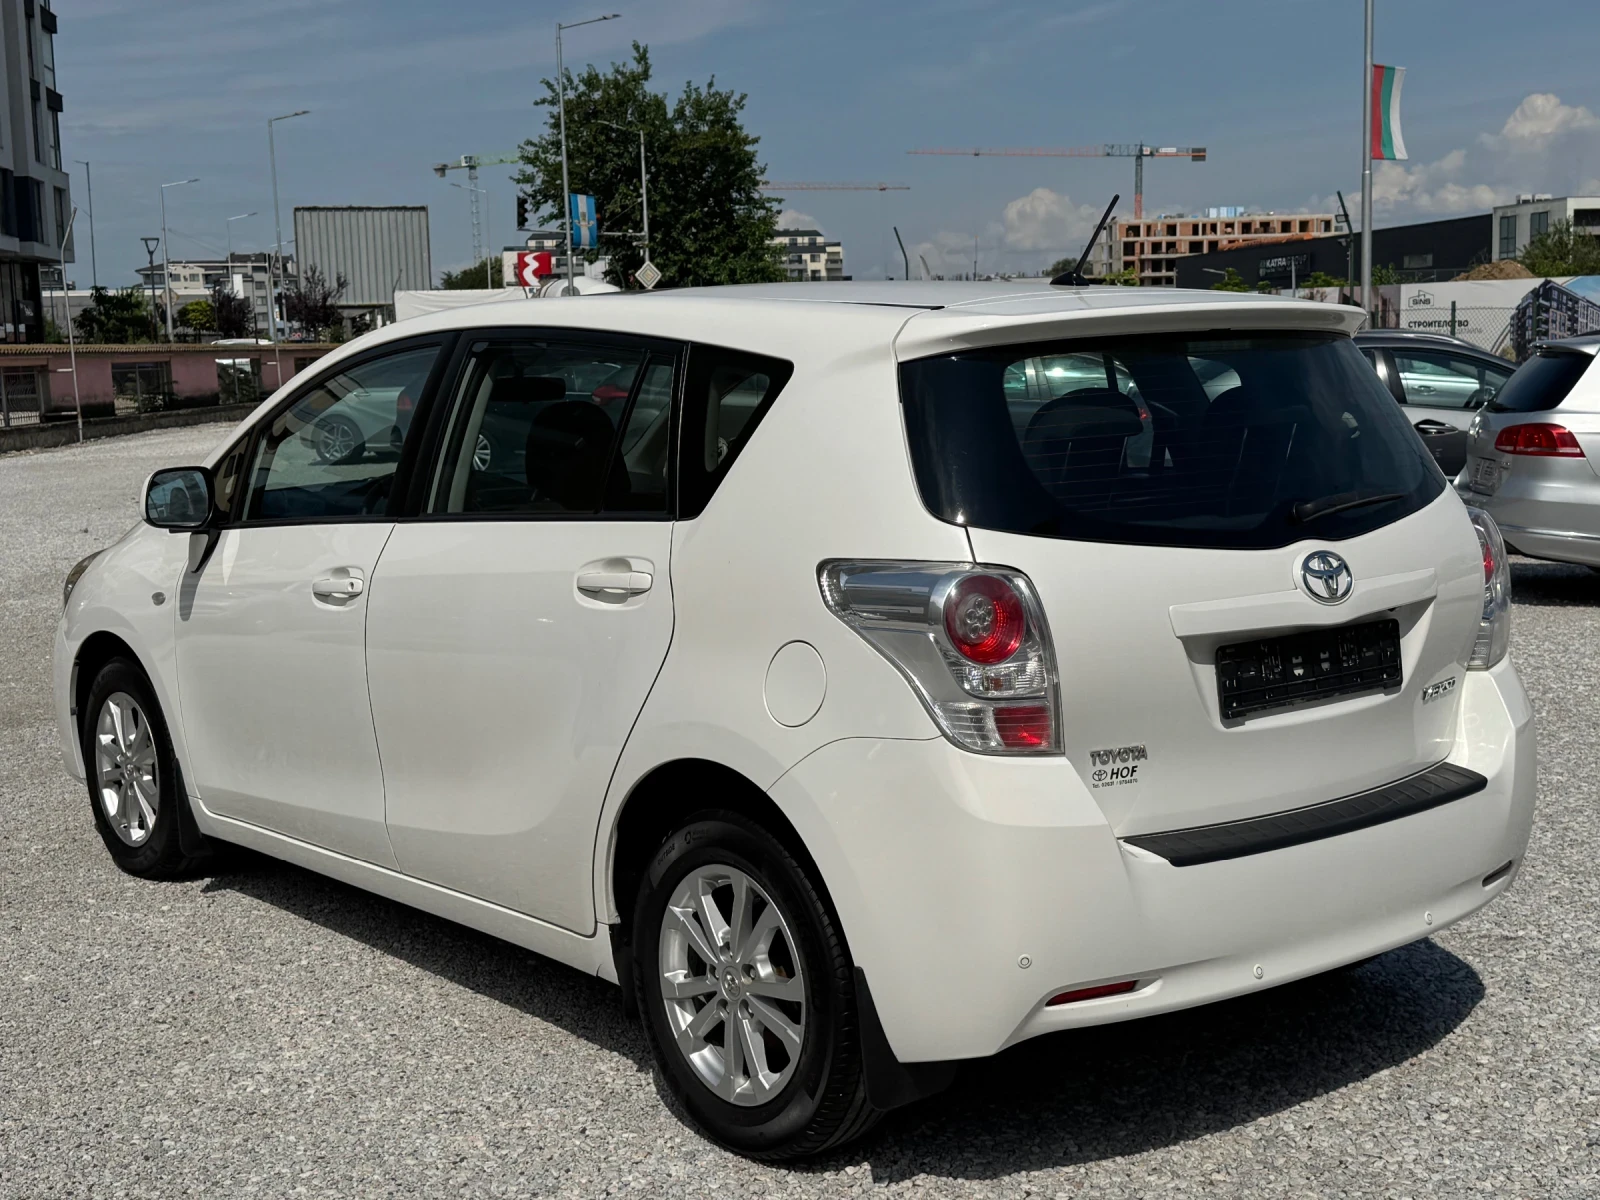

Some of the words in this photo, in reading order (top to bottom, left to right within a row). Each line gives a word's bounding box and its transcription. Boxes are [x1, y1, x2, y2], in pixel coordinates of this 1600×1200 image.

[1266, 257, 1287, 268] KATRA
[1090, 745, 1147, 766] TOYOTA
[1109, 765, 1138, 780] HOF
